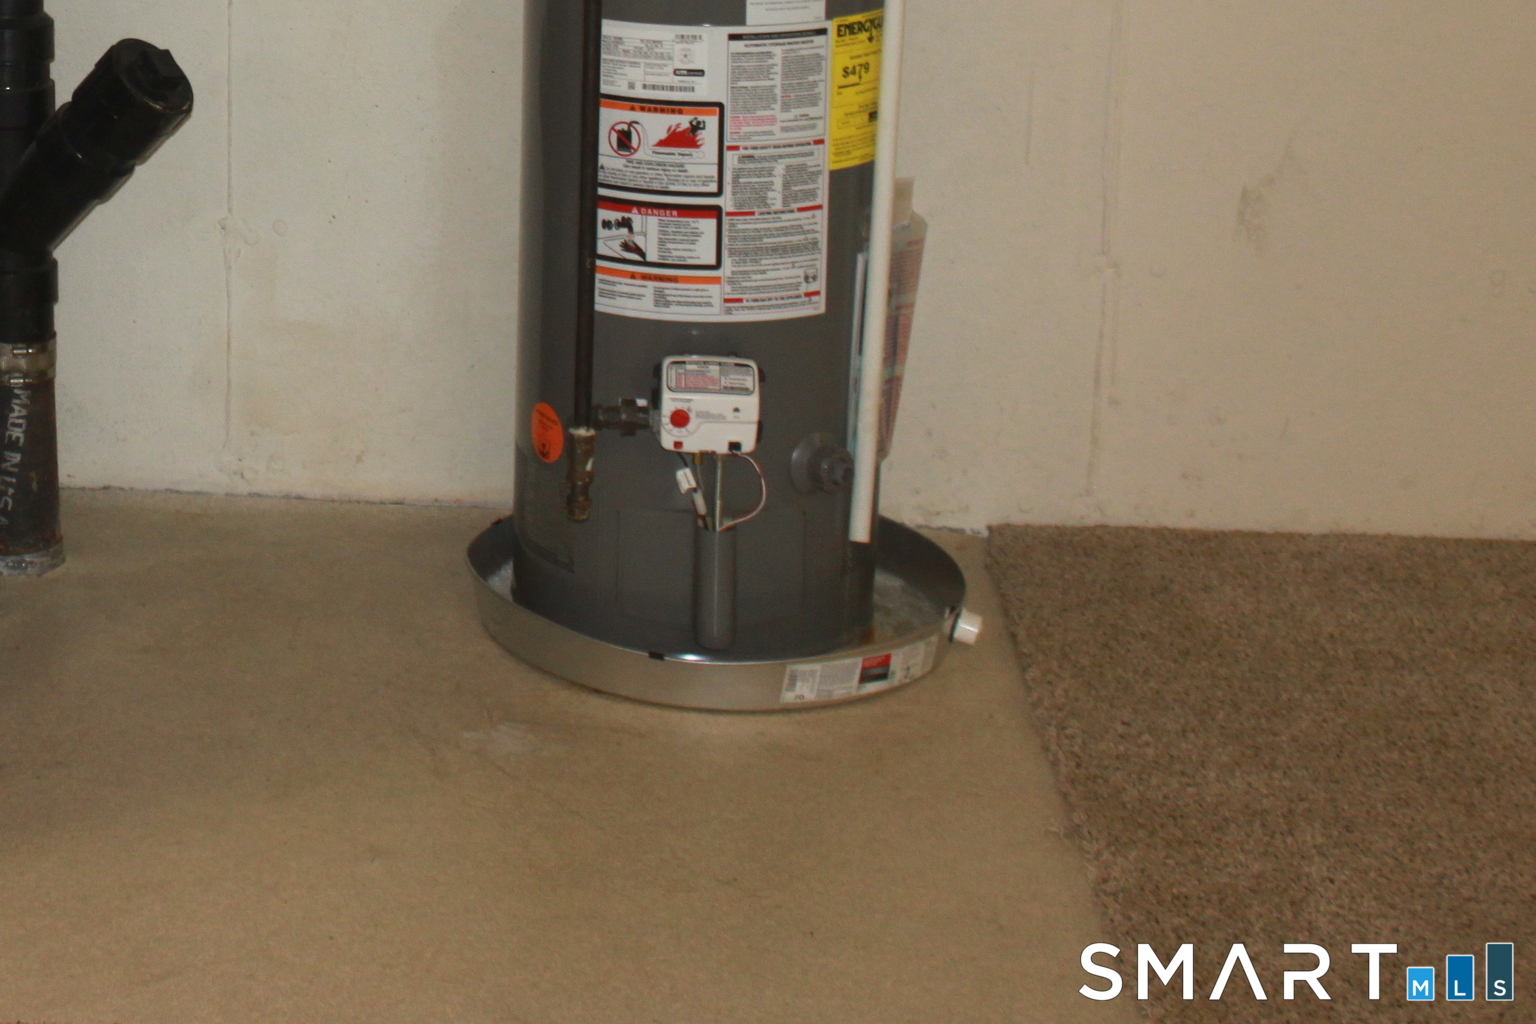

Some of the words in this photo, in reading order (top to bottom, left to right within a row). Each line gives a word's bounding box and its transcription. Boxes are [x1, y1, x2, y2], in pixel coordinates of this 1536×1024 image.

[639, 105, 683, 115] WARNING
[640, 207, 678, 217] DANGER
[640, 272, 679, 283] WARNING
[5, 388, 31, 447] MADE
